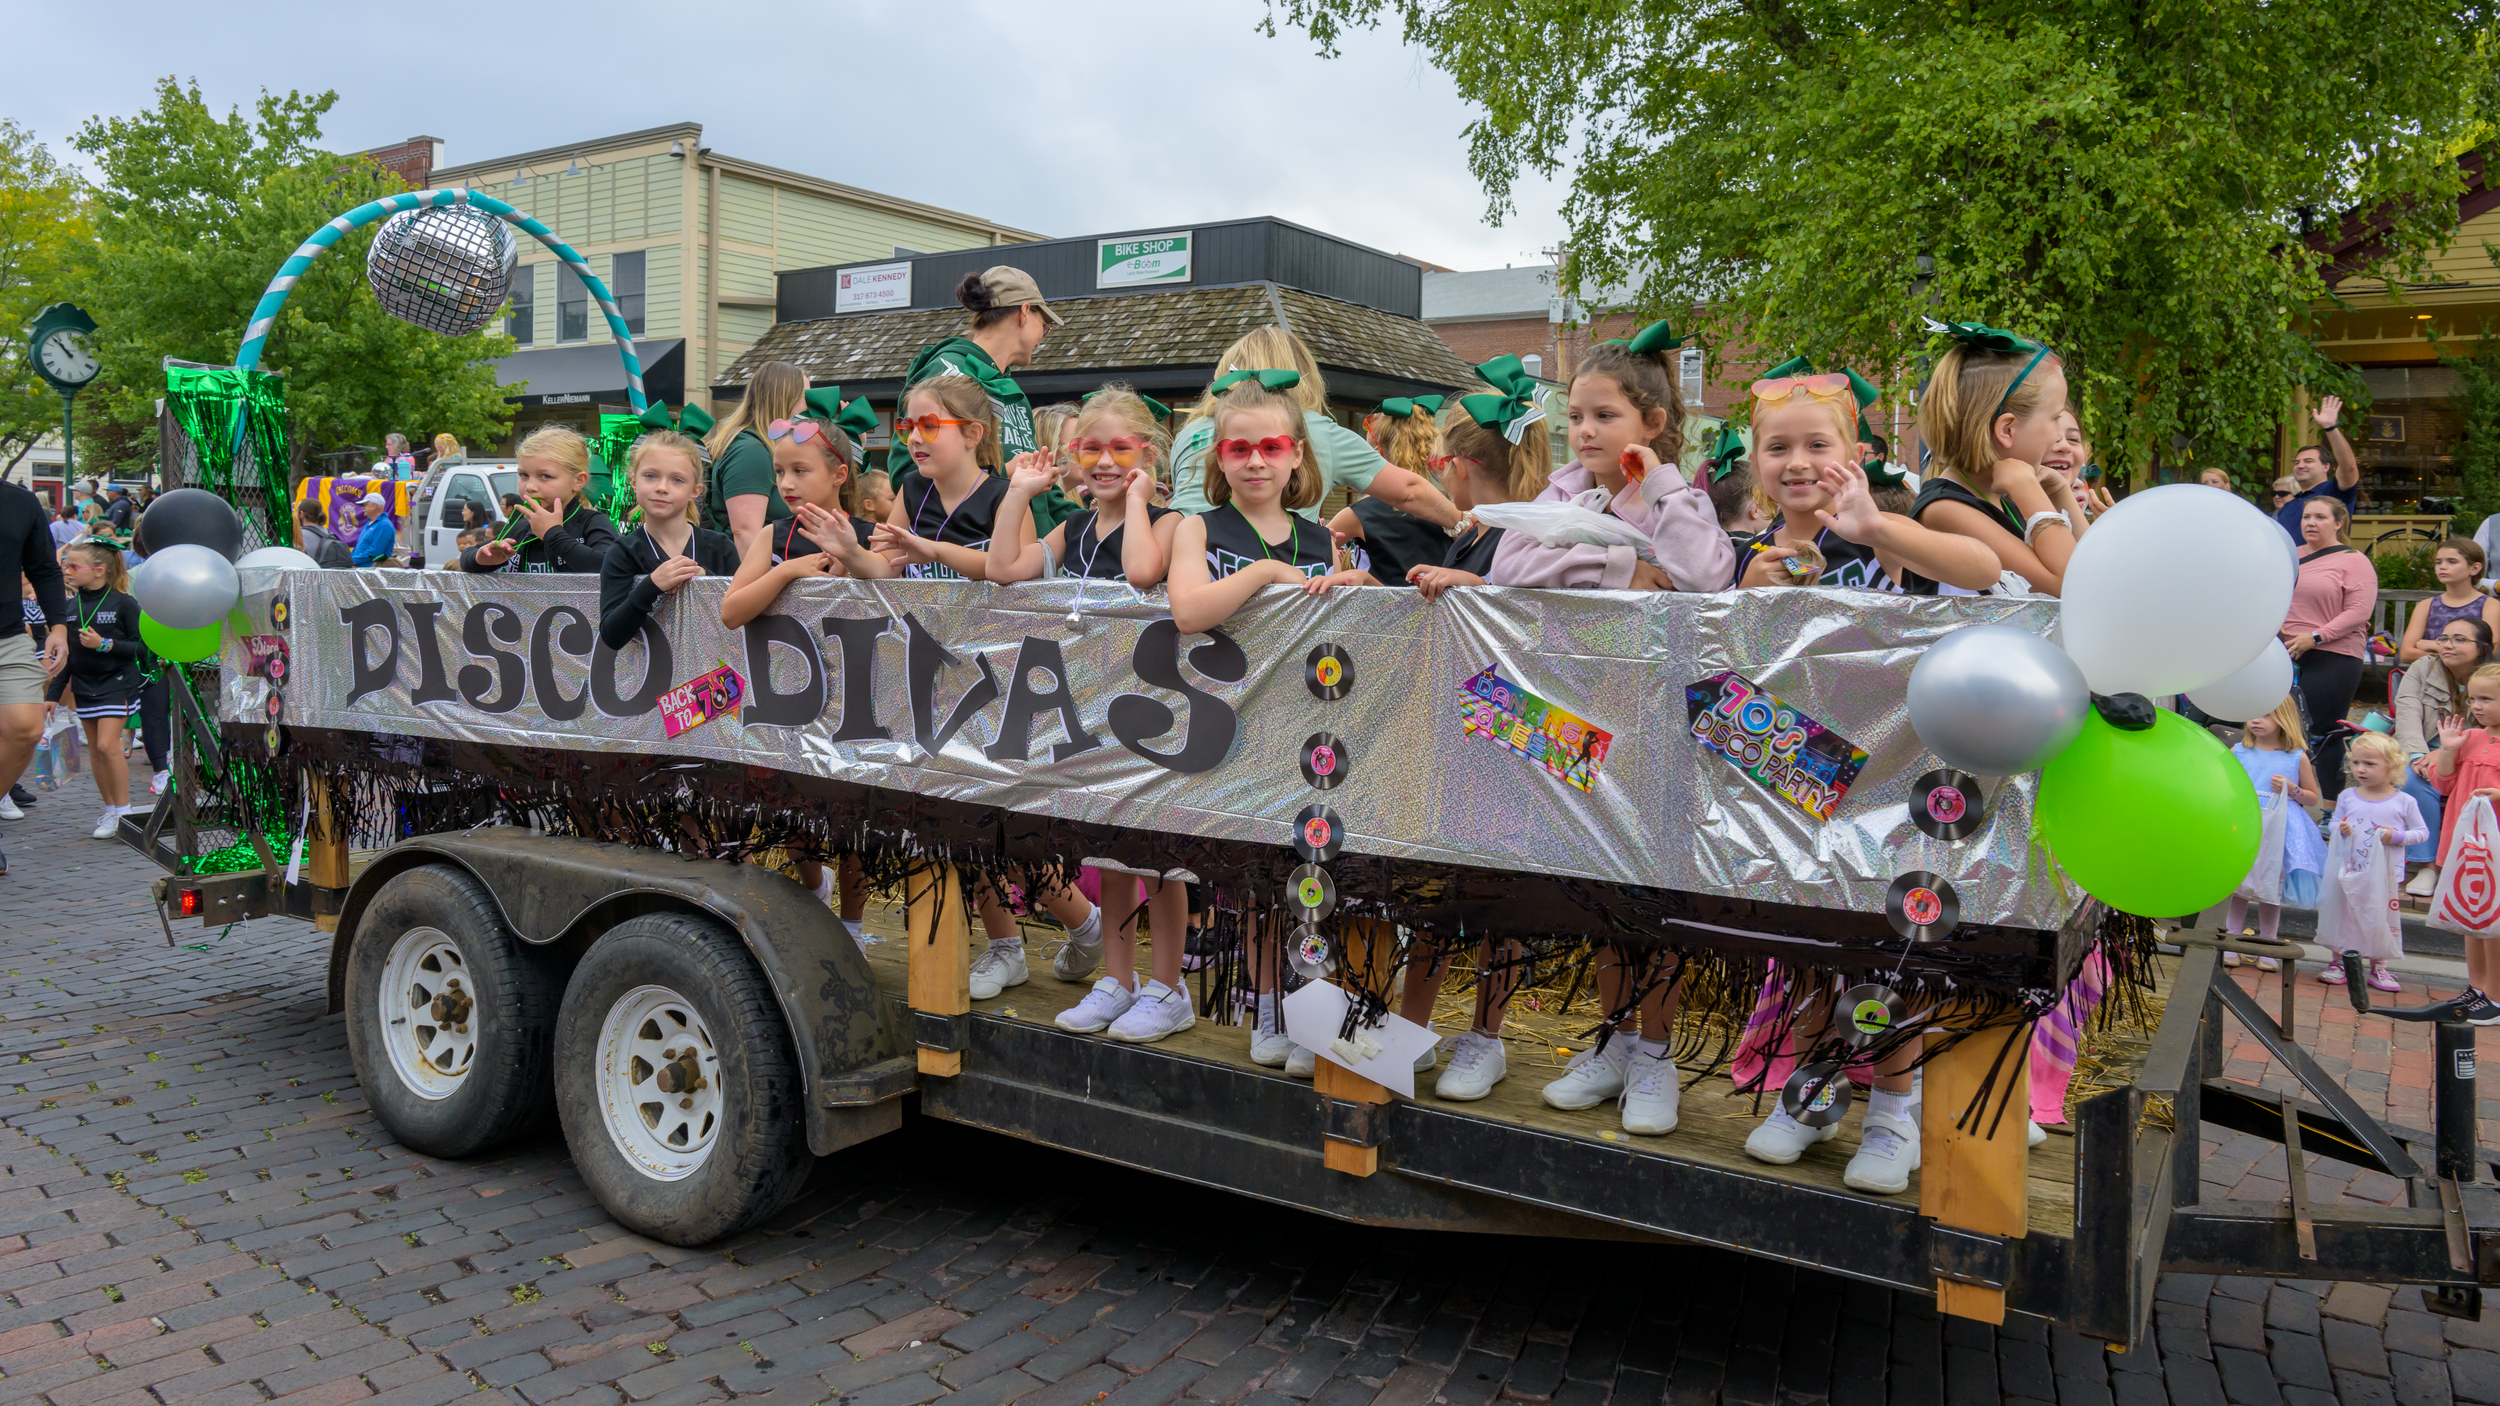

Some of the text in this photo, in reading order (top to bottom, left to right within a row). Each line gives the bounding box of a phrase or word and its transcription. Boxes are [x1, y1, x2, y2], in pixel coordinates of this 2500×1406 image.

[1115, 240, 1174, 256] BIKE SHOP
[853, 272, 907, 285] DALE KENNEDY
[340, 598, 1248, 774] DISCO DIVAS
[659, 684, 697, 716] BACK
[1475, 676, 1582, 744] DANCING
[674, 708, 693, 731] TO
[1474, 705, 1567, 771] QUEEN
[1692, 711, 1838, 812] DISCO PARTY
